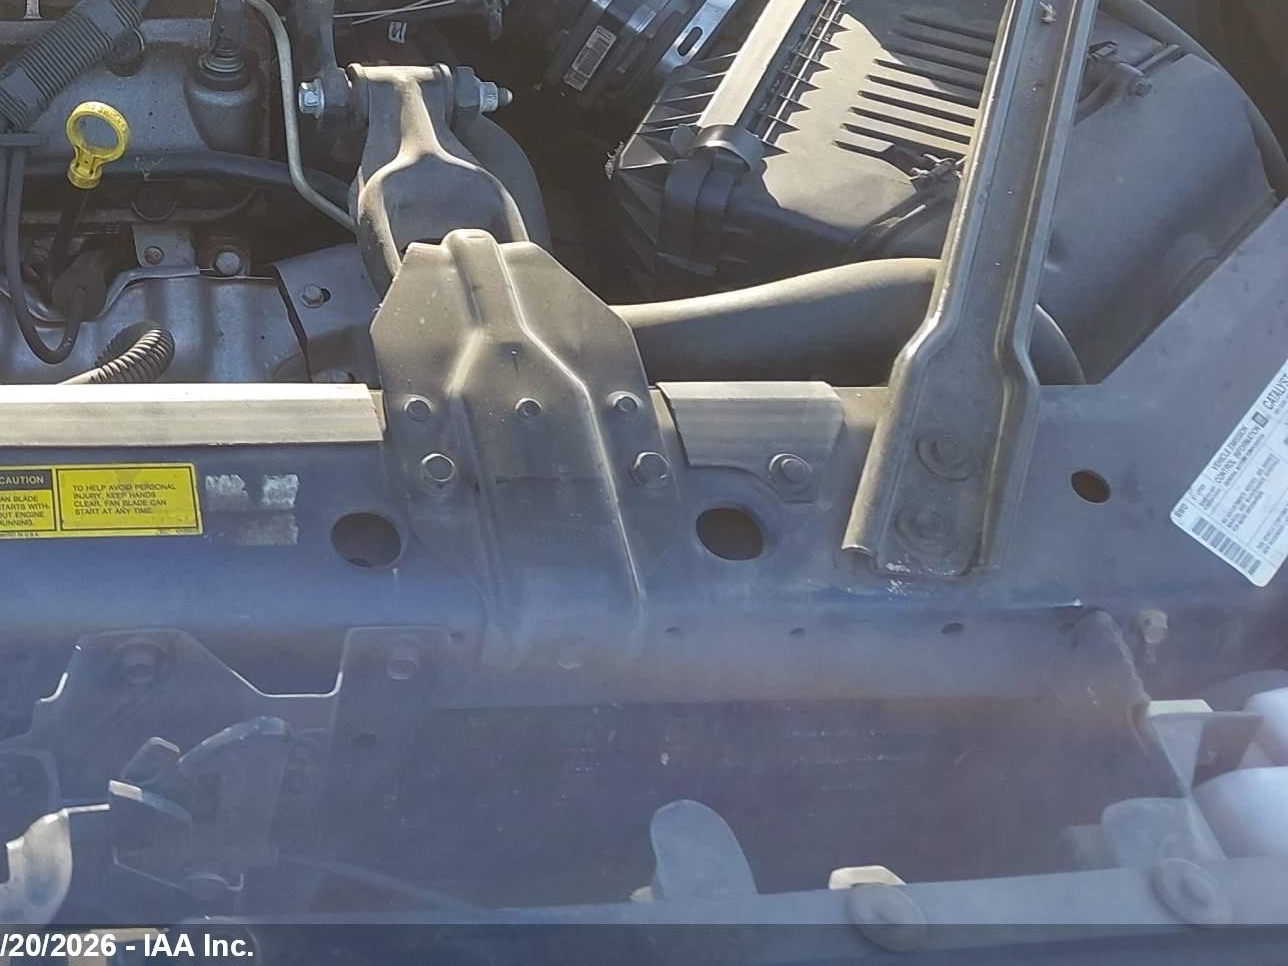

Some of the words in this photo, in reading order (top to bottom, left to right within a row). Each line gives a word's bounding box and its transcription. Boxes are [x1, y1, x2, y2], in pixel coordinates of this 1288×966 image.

[1211, 445, 1231, 471] VEHICLE
[1214, 459, 1235, 485] CONTROL
[135, 483, 177, 491] PERSONAL
